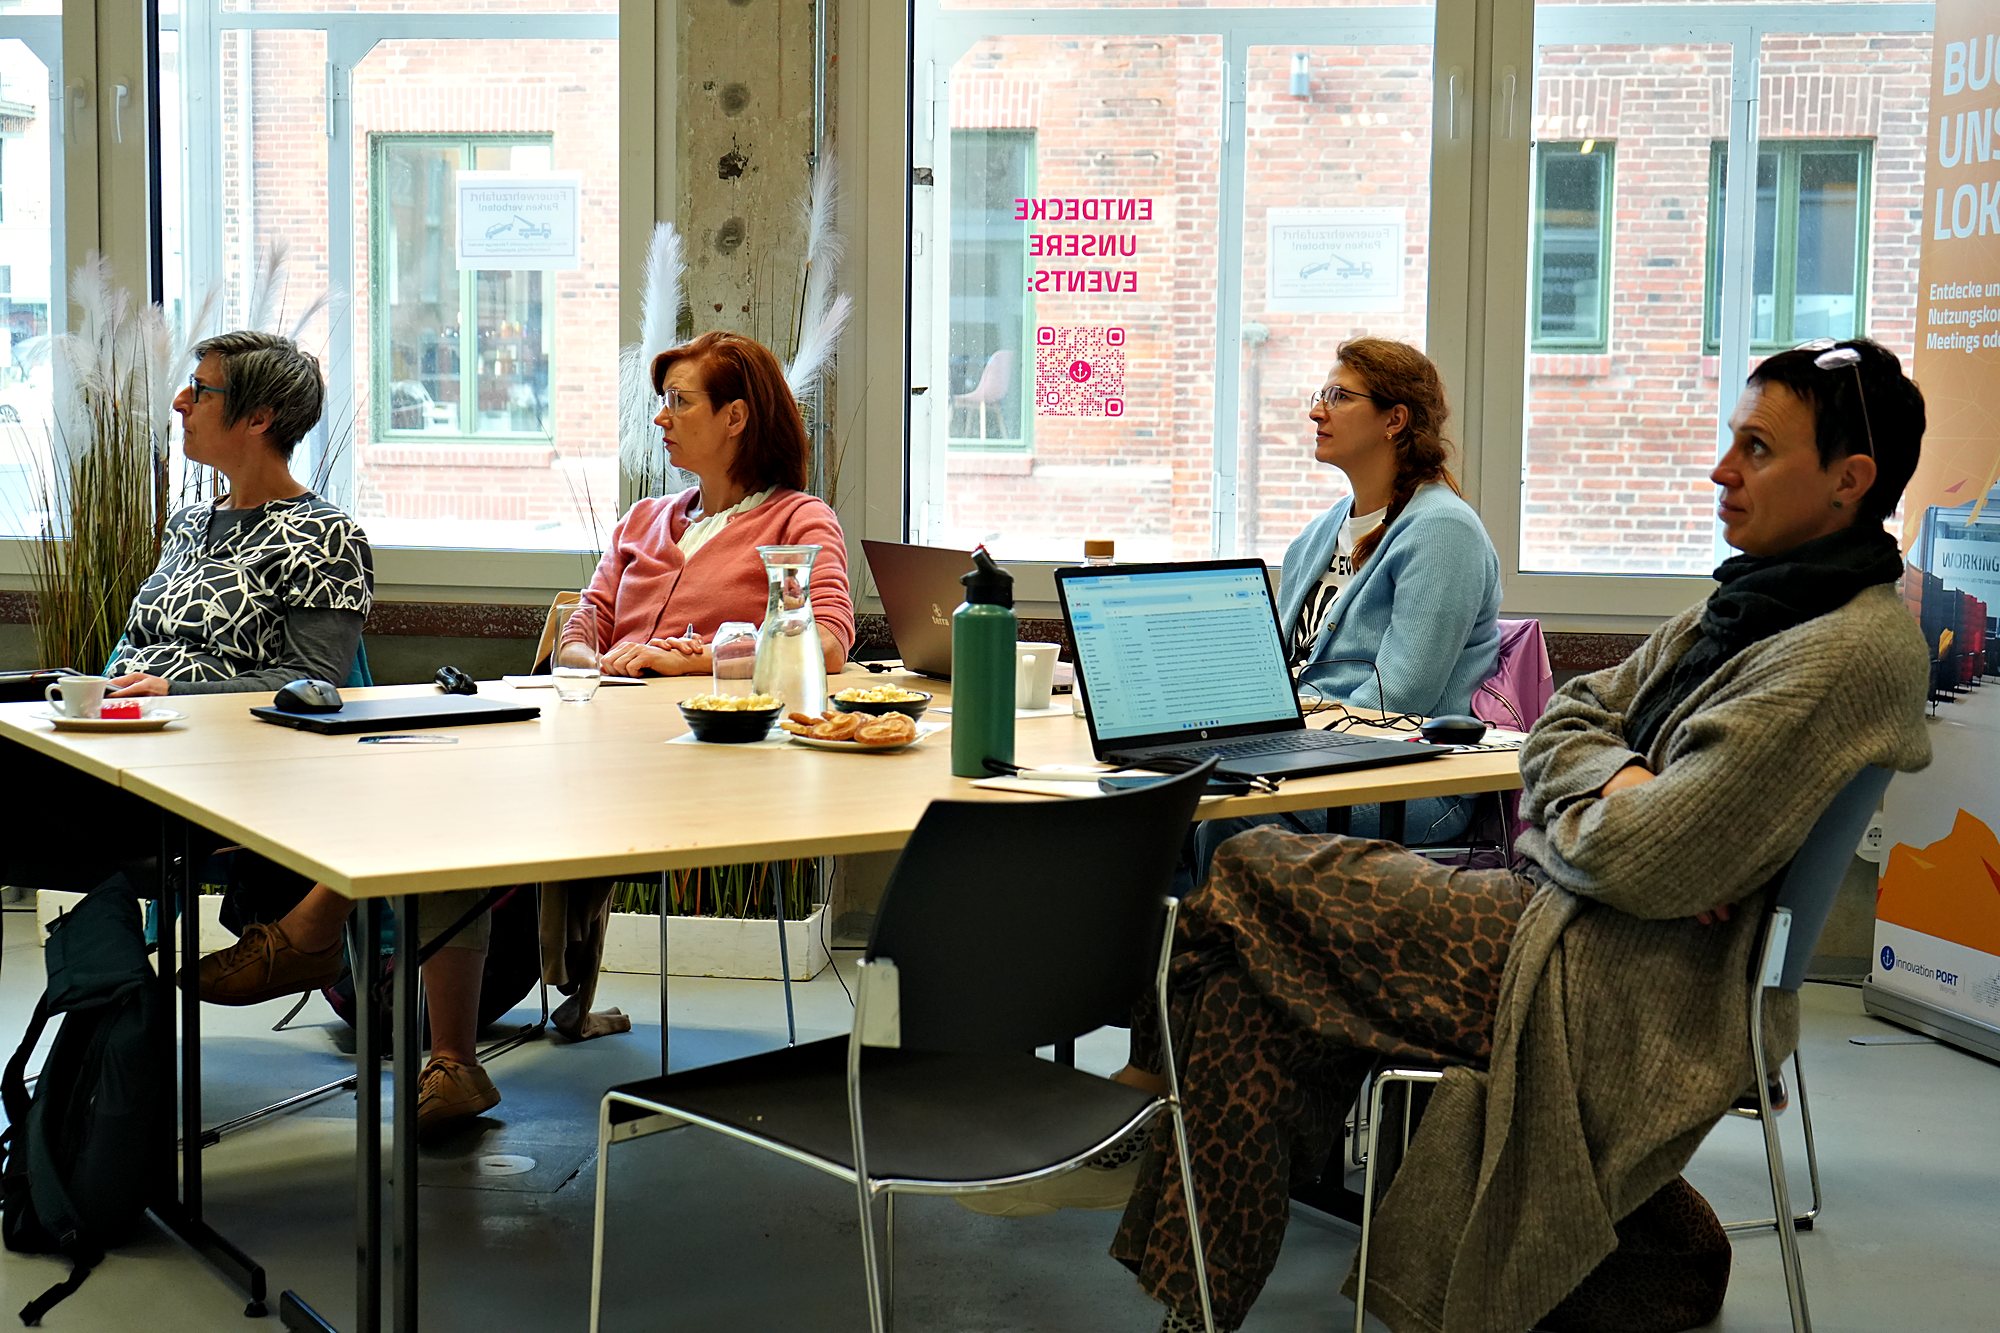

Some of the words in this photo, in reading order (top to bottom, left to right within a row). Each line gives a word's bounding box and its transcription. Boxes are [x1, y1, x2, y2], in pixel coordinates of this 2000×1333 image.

[1943, 34, 2000, 96] BU
[1934, 181, 2000, 240] LOK
[1930, 281, 1982, 300] Entdecke
[1928, 304, 2000, 328] Nutzungsko
[1926, 331, 1979, 353] Meetings
[1983, 330, 2000, 348] od
[1942, 551, 2000, 573] WORKING
[1895, 956, 1935, 979] innovation
[1935, 968, 1959, 986] PORT
